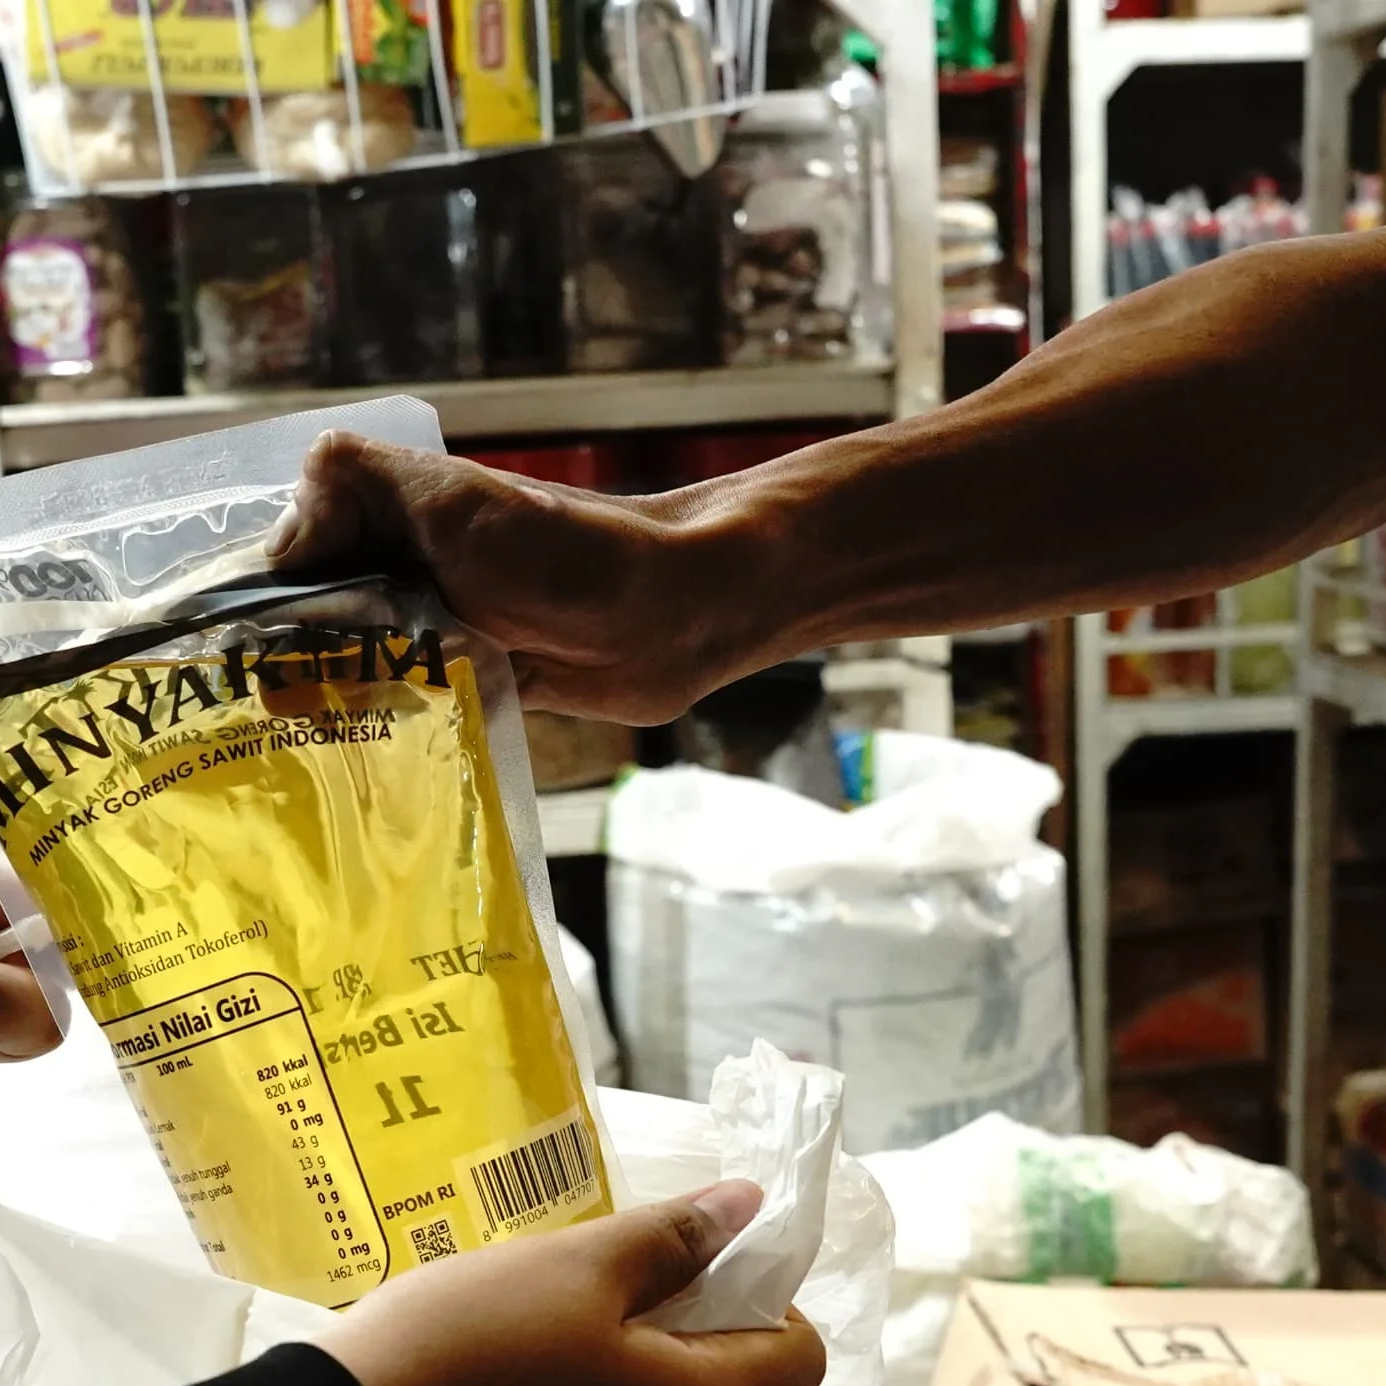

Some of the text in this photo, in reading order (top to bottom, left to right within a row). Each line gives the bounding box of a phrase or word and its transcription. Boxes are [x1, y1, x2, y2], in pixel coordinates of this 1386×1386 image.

[29, 723, 393, 867] MINYAK GORENG SAWIT INDONESIA
[92, 953, 115, 969] dan
[113, 929, 173, 960] Vitamin
[176, 921, 189, 936] A
[106, 950, 185, 991] Antioksidan
[185, 919, 269, 961] Tokoferol)
[160, 1005, 213, 1043] Nilai
[216, 988, 262, 1023] Gizi
[157, 1055, 194, 1076] 100 mL
[256, 1054, 309, 1082] 820 kkal
[264, 1073, 313, 1100] 820 kkal
[277, 1099, 307, 1116] 91 g
[290, 1113, 324, 1131] 0 mg
[292, 1135, 319, 1150] 43 g
[299, 1155, 326, 1171] 13 g
[304, 1173, 333, 1189] 34 g
[208, 1183, 233, 1202] ganda
[317, 1190, 340, 1204] 0 g
[382, 1182, 457, 1220] BPOM RI
[324, 1209, 347, 1223] 0 g
[482, 1230, 492, 1243] 8
[505, 1207, 550, 1234] 991004
[331, 1227, 353, 1241] 0 g
[338, 1242, 371, 1260] 0 mg
[327, 1258, 382, 1283] 1462 mcg
